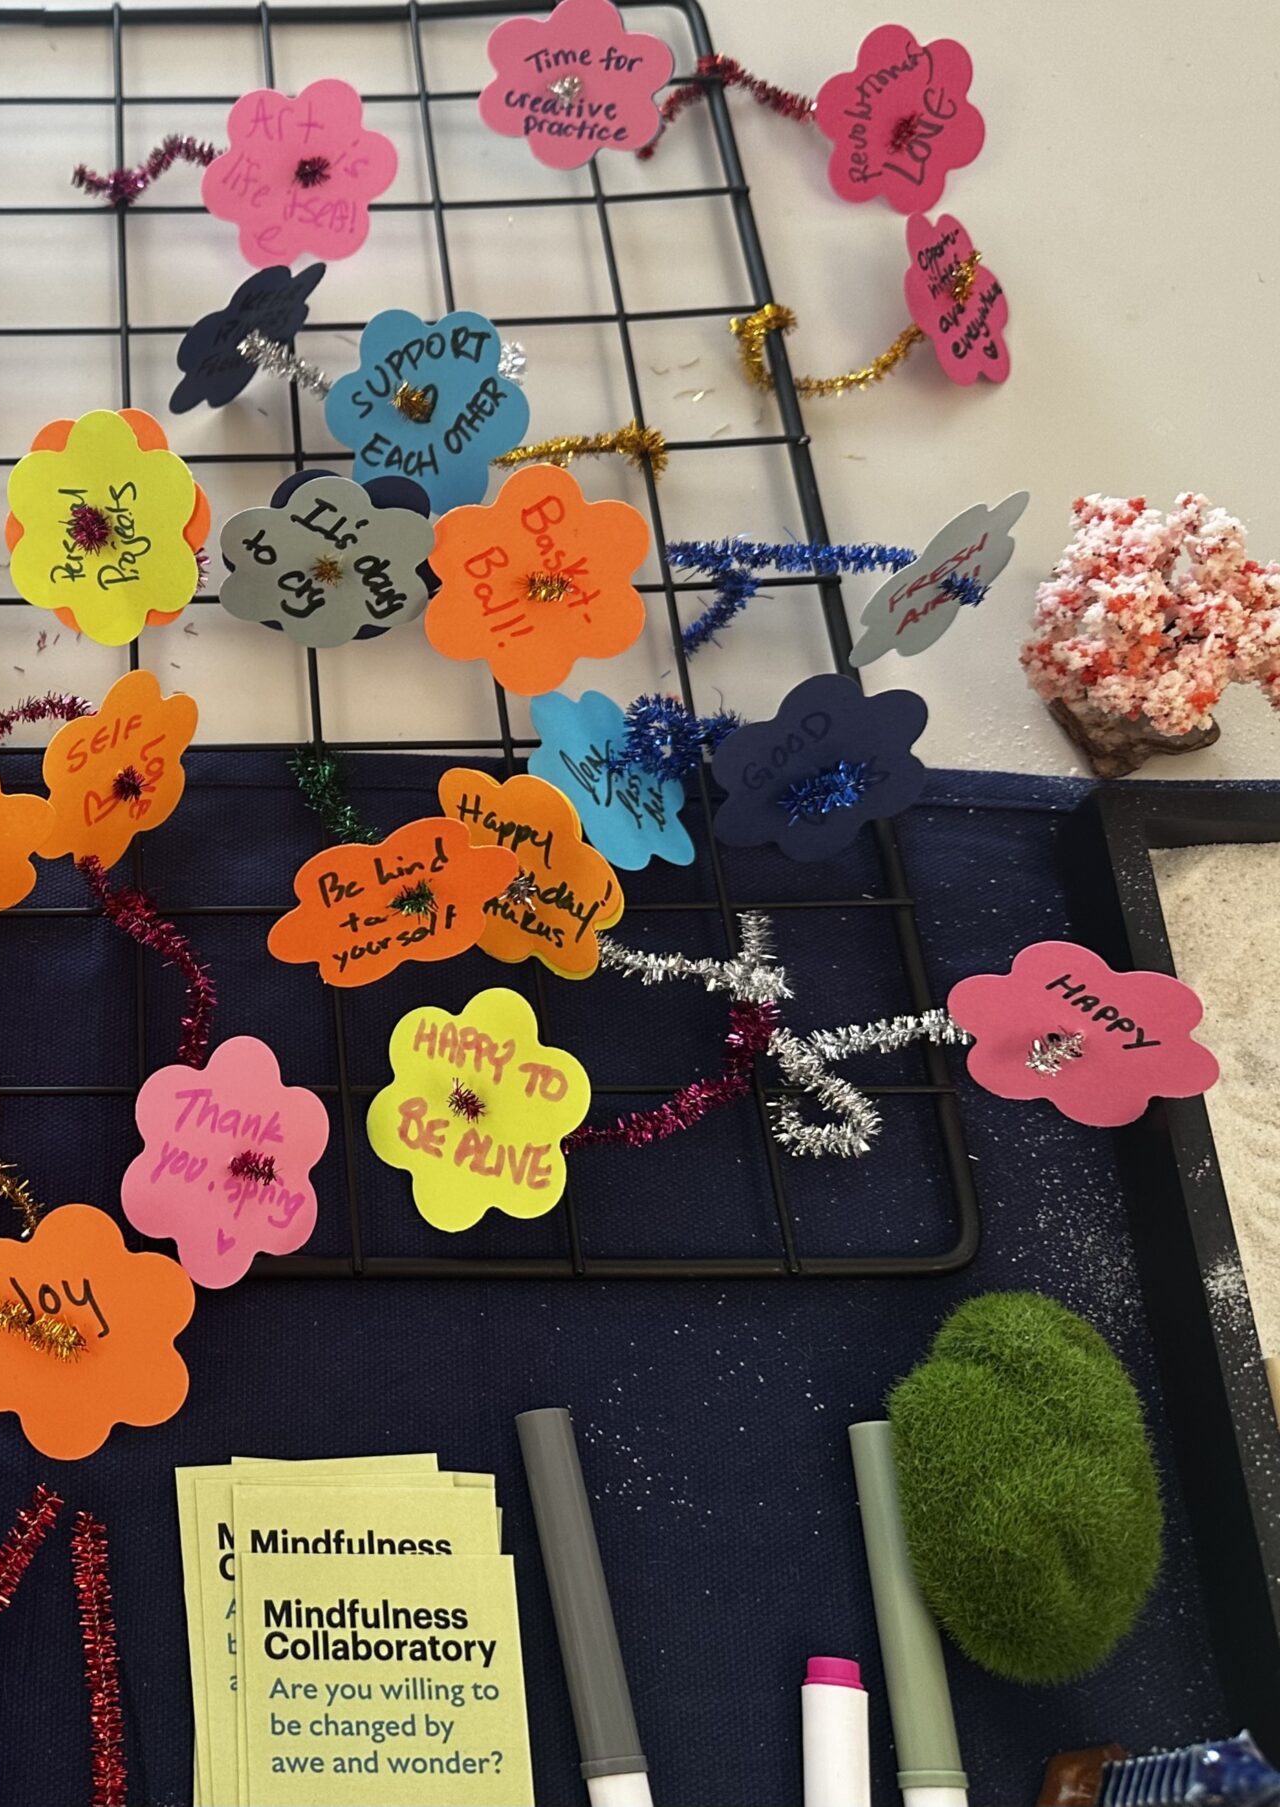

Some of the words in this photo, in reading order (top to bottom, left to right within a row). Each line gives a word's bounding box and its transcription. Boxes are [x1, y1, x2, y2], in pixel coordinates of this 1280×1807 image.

[523, 47, 593, 73] Time
[598, 46, 643, 72] for
[504, 89, 618, 121] creative
[523, 114, 630, 142] practice
[351, 325, 492, 420] SUPPORT
[360, 433, 440, 476] EACH
[443, 376, 509, 455] OTHER
[241, 528, 278, 566] to
[456, 793, 554, 870] Happy
[318, 872, 365, 908] Be
[1044, 973, 1162, 1050] HAPPY
[412, 1017, 517, 1086] HAPPY
[518, 1061, 569, 1103] TO
[174, 1087, 285, 1146] Thank
[397, 1095, 451, 1159] BE
[452, 1126, 553, 1190] ALIVE
[249, 1528, 453, 1555] Mindfulness
[263, 1599, 469, 1630] Mindfulness
[263, 1630, 498, 1668] Collaboratory
[268, 1677, 319, 1700] Are
[325, 1682, 373, 1707] you
[380, 1677, 466, 1707] willing
[471, 1681, 501, 1701] to
[270, 1713, 302, 1736] be
[308, 1714, 417, 1744] changed
[424, 1714, 456, 1744] by
[271, 1758, 326, 1774] awe
[332, 1751, 380, 1774] and
[386, 1750, 505, 1775] wonder?
